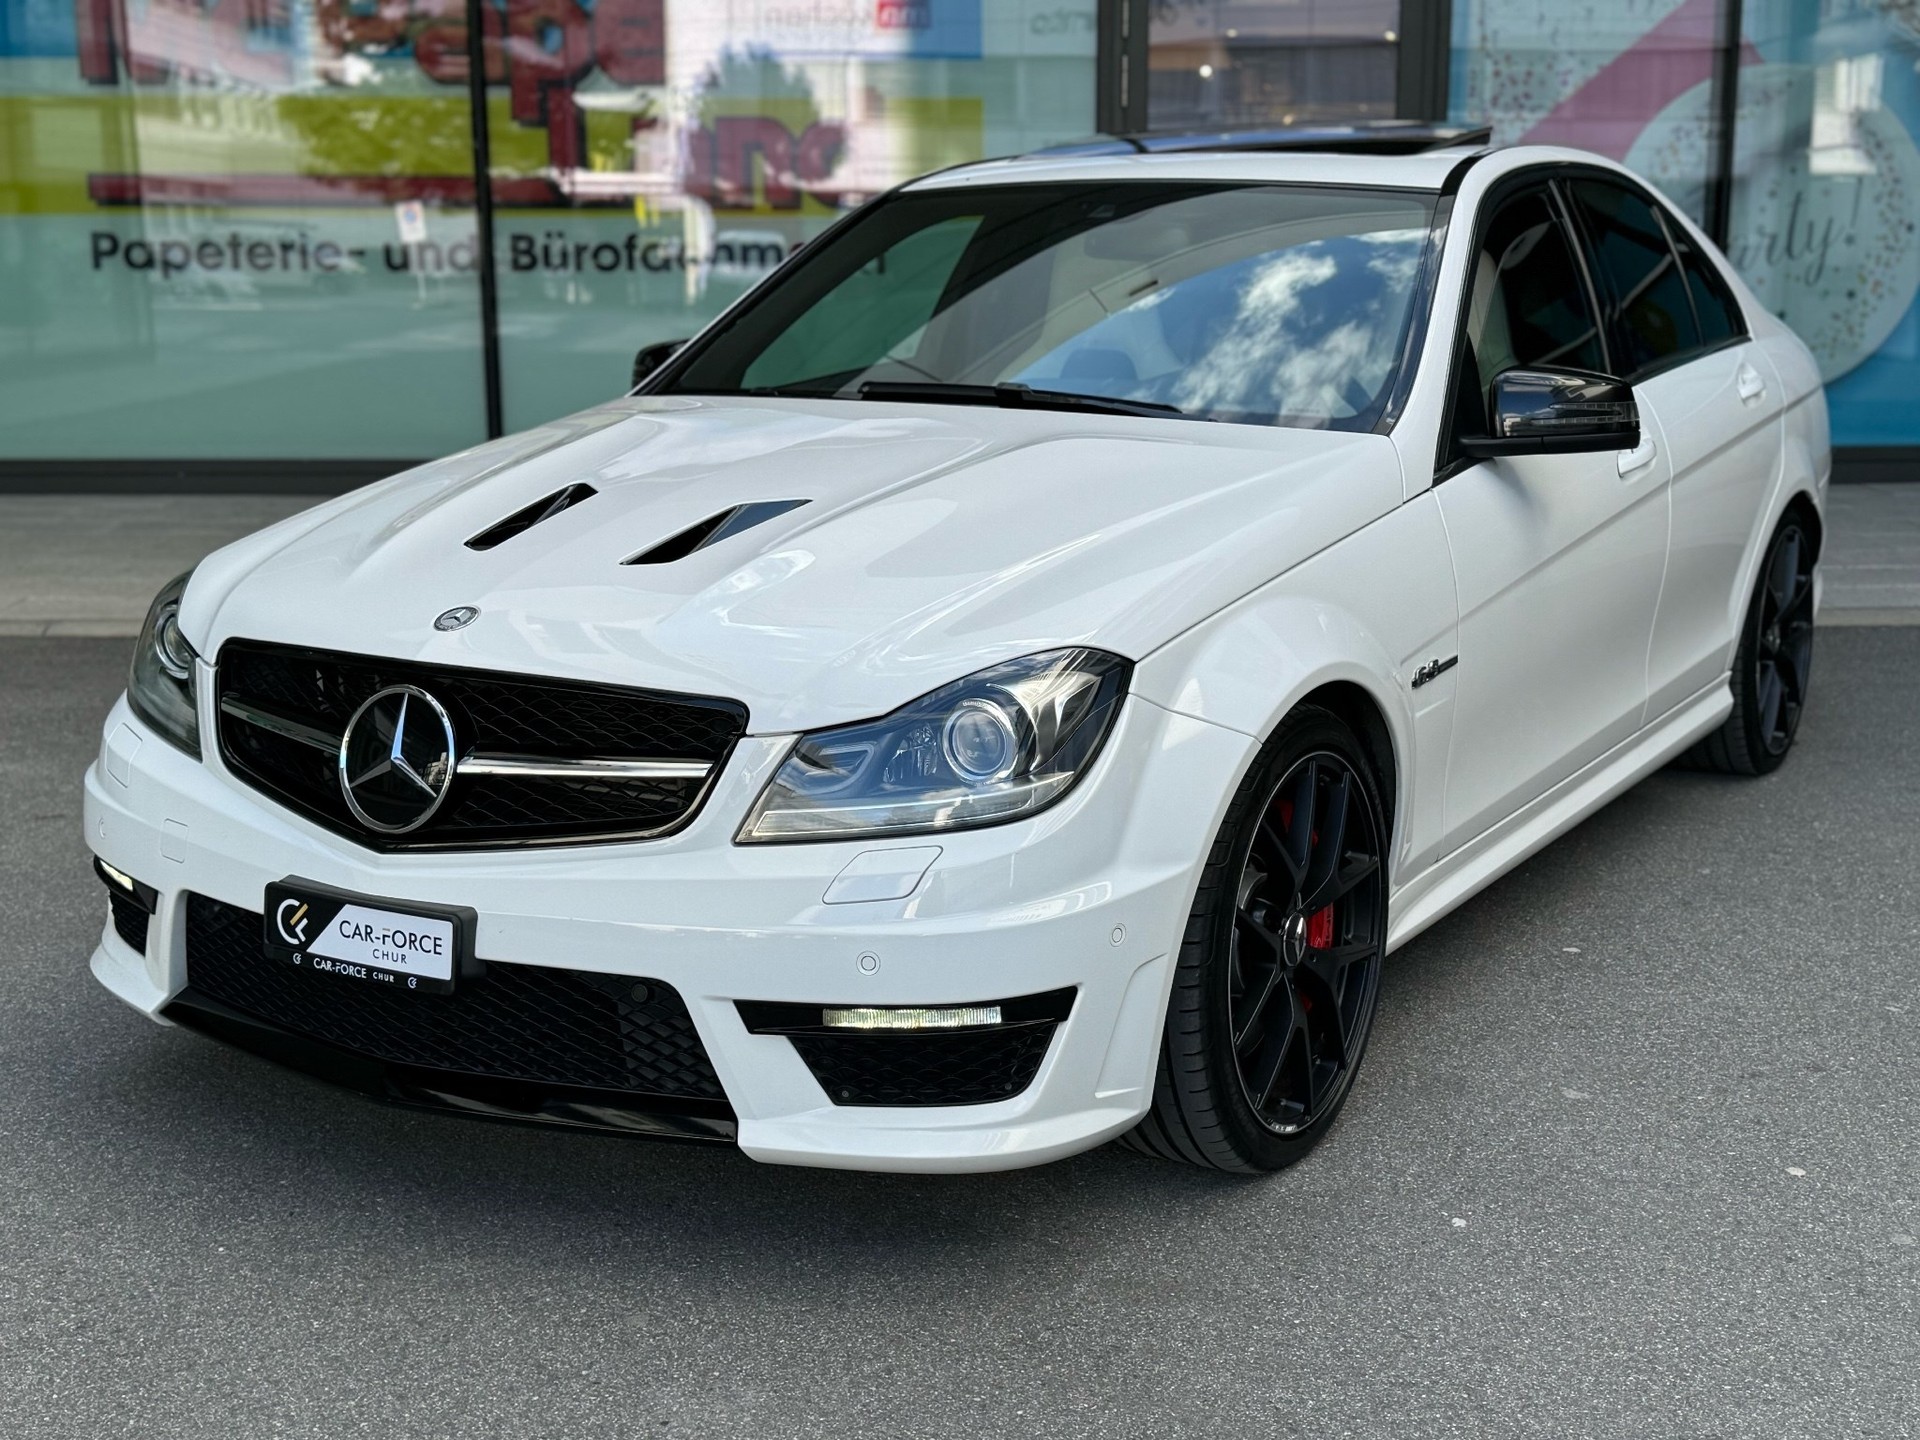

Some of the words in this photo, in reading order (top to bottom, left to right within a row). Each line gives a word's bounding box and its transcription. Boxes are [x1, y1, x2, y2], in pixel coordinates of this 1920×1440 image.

[91, 231, 366, 279] Papeterie-
[384, 231, 479, 273] und
[339, 919, 443, 956] CAR-FORCE
[313, 957, 367, 979] CAR-FORCE
[372, 971, 395, 983] CHUR
[372, 948, 408, 965] CHUR
